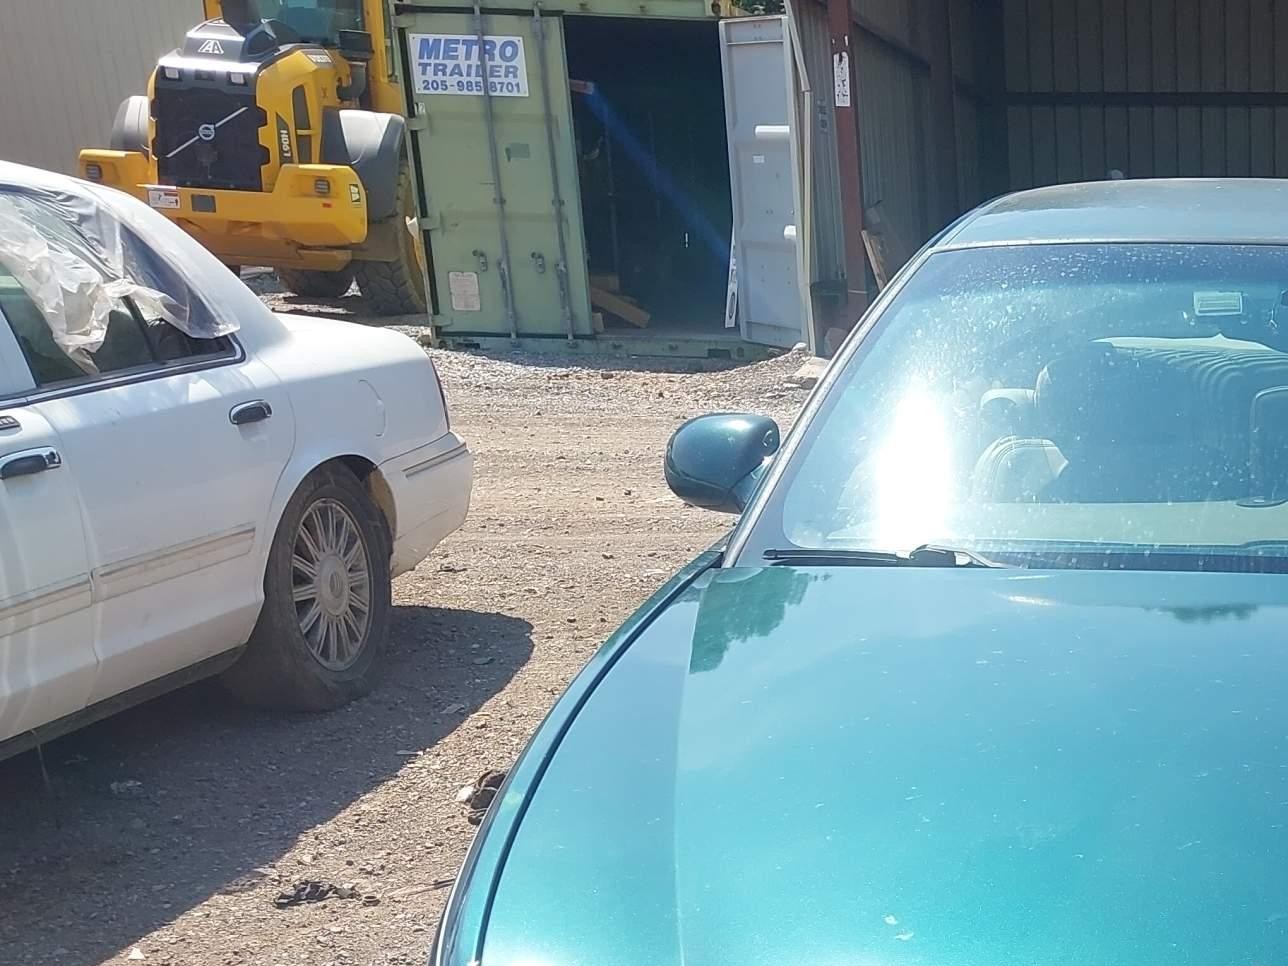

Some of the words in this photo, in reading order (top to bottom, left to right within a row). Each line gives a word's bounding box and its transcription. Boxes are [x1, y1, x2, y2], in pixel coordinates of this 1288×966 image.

[418, 38, 519, 63] METRO
[418, 62, 520, 79] TRAILER
[422, 80, 521, 93] 205-9858701
